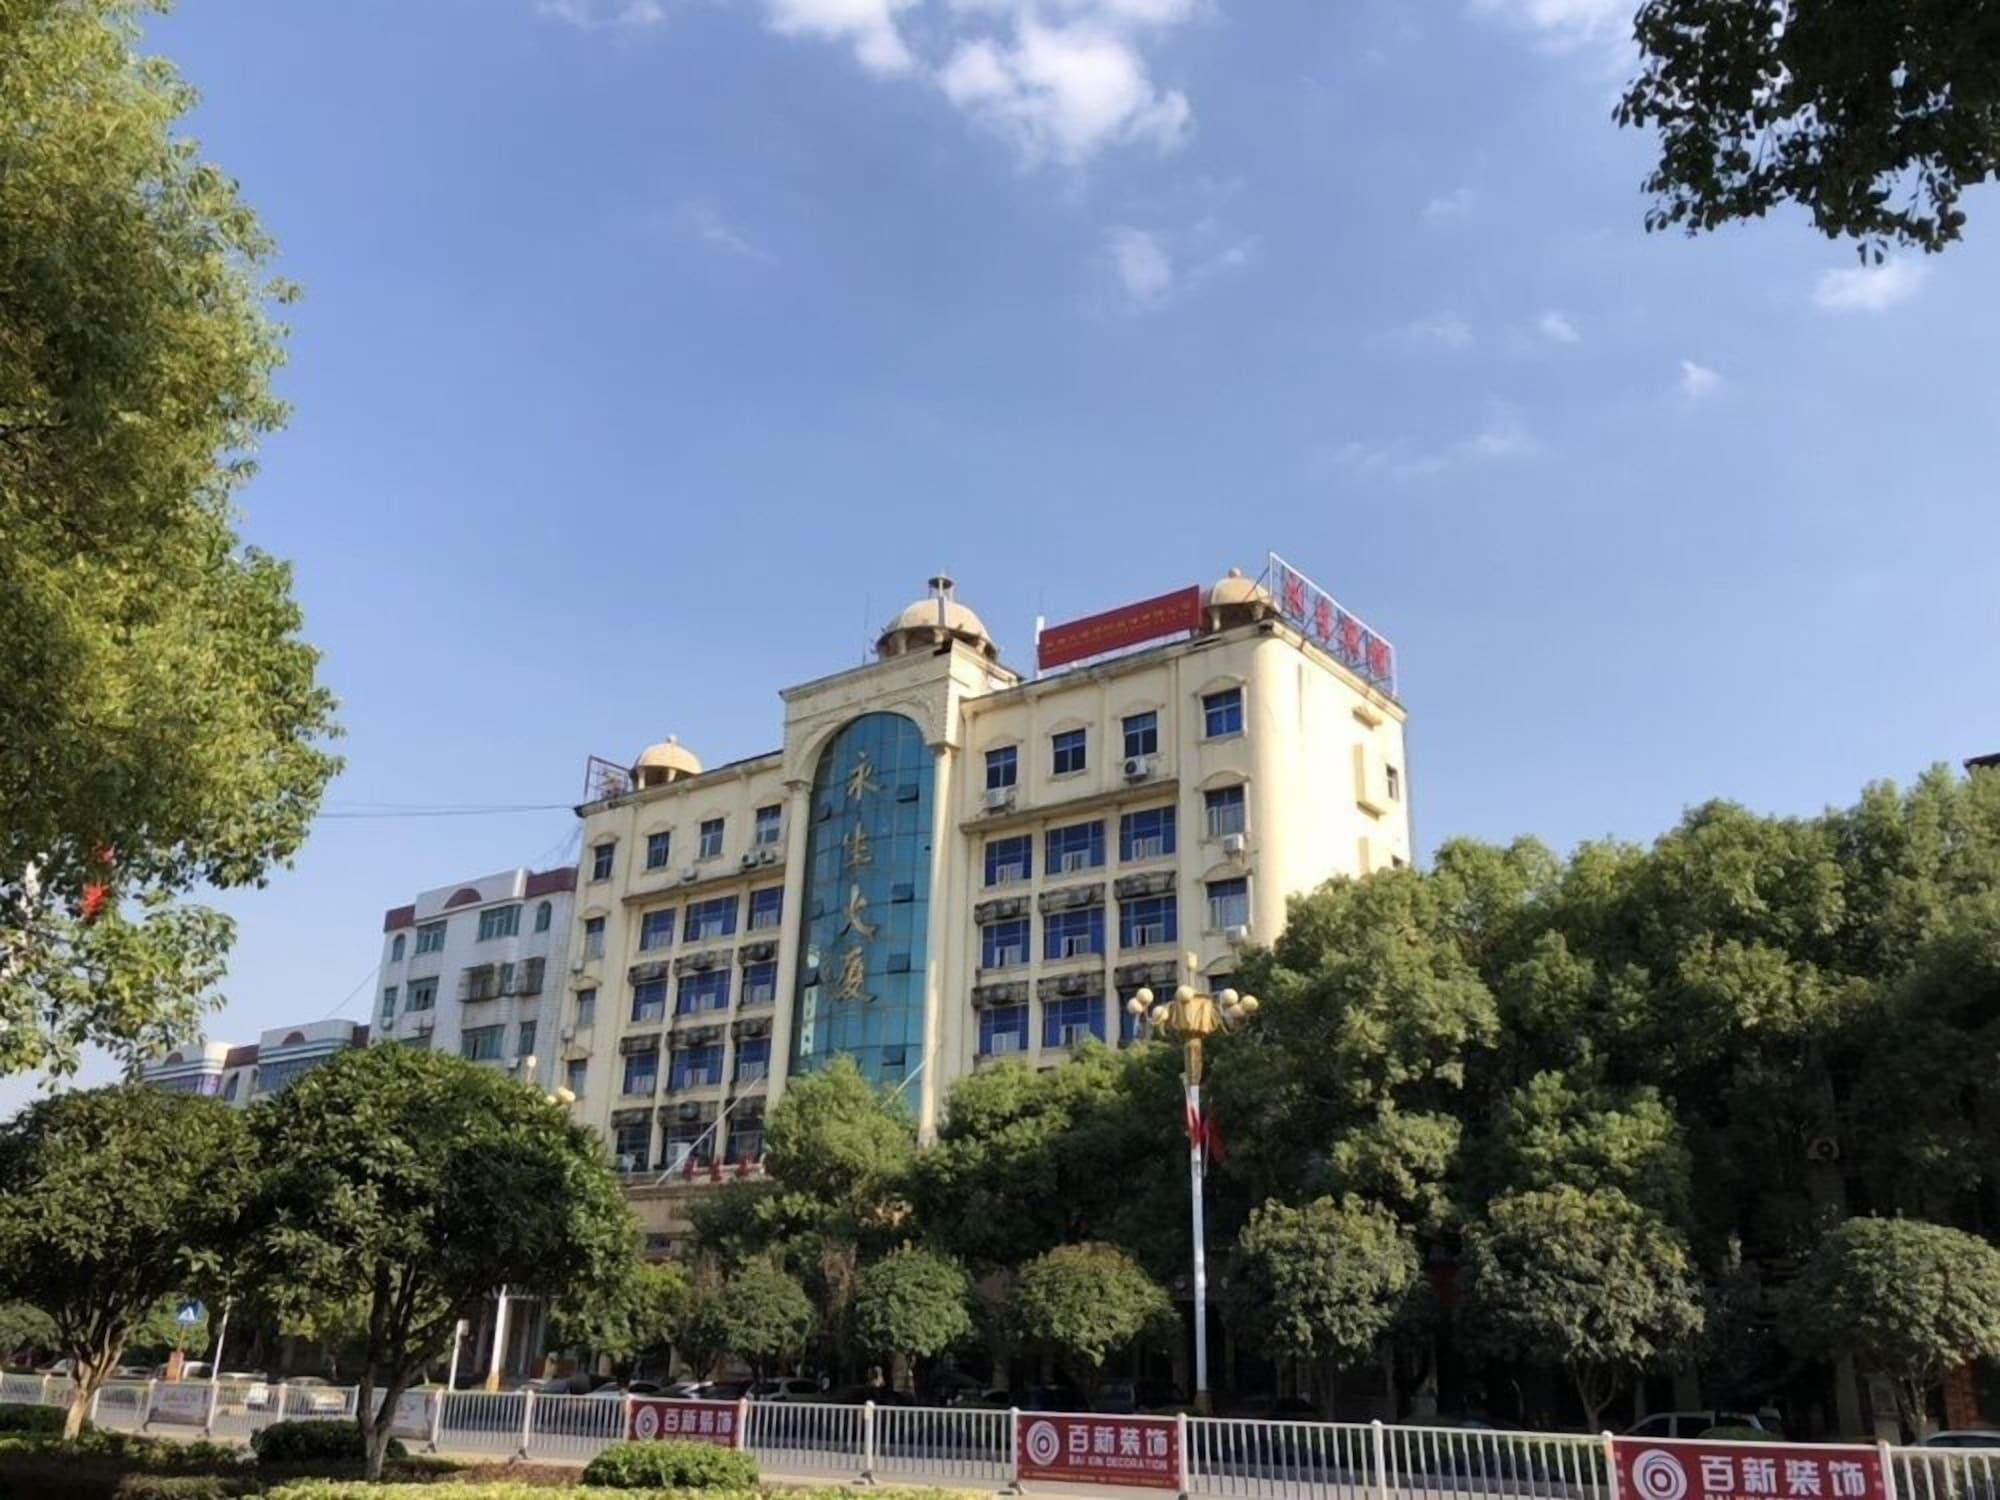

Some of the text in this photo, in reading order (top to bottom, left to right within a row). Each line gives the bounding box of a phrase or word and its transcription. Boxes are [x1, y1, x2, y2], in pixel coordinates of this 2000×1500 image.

[830, 751, 888, 1003] 永佳大厦
[664, 1407, 733, 1433] 百新装饰
[1068, 1424, 1168, 1457] 百新装饰
[1700, 1455, 1867, 1497] 百新装饰
